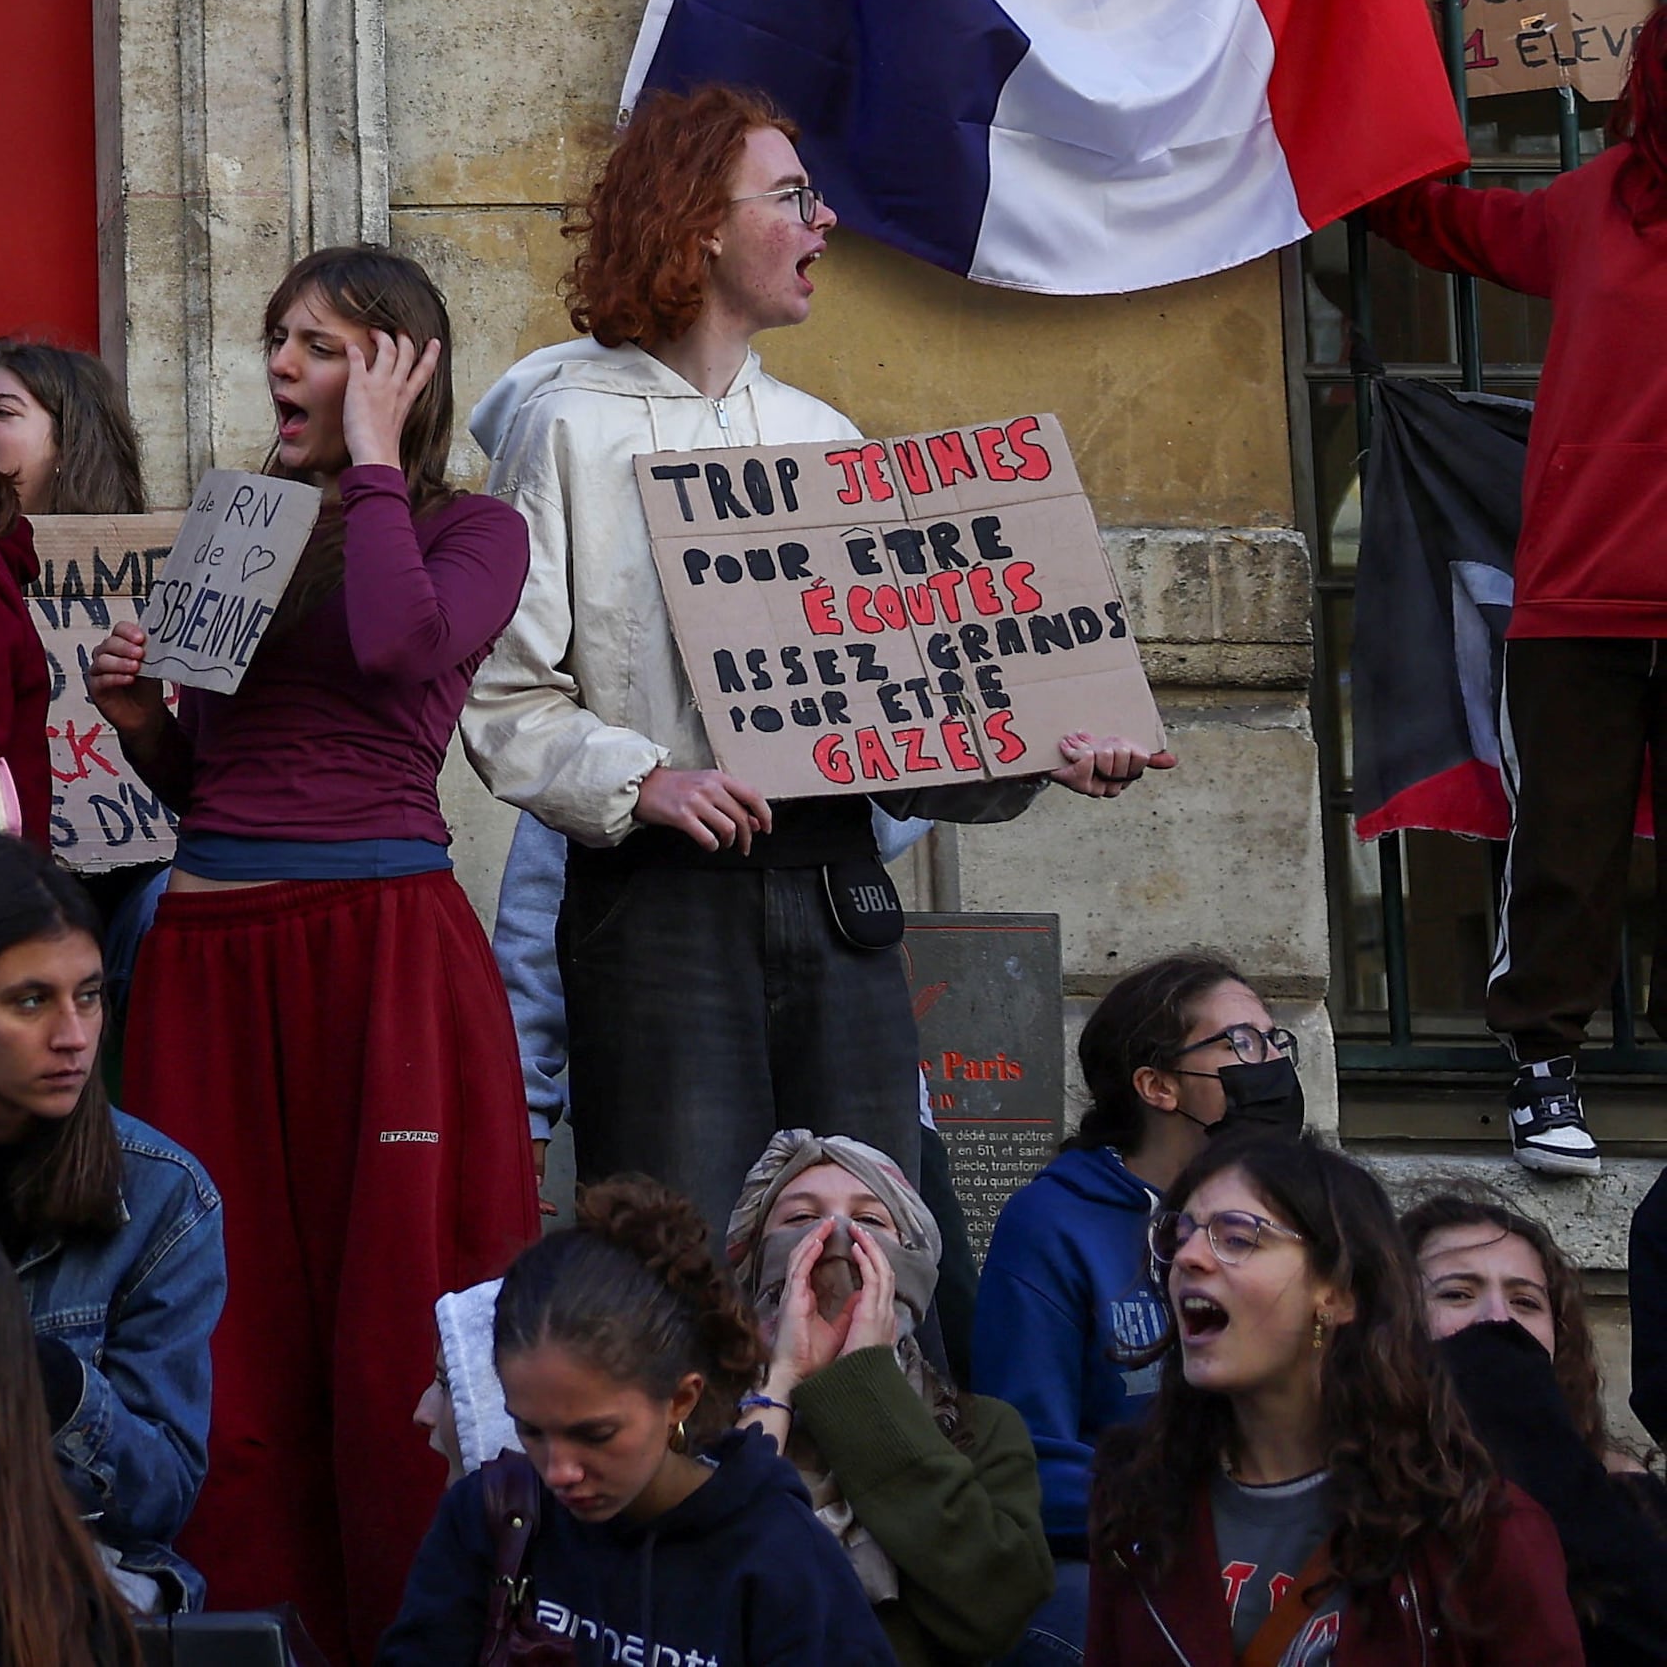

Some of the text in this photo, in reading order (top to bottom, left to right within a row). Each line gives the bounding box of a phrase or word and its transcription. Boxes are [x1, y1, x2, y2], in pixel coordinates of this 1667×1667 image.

[651, 416, 1051, 521] TROP JEUNES
[196, 485, 283, 528] de RN
[194, 534, 225, 566] de
[682, 515, 1013, 586] POUR ÊTRE
[801, 561, 1043, 635] ÉCOUTÉS
[712, 601, 1128, 692] ASSEZ GRANDS
[729, 691, 851, 732] POUR
[812, 710, 1027, 784] GAZÉS
[854, 885, 898, 913] JBL
[942, 1051, 1023, 1081] Paris
[956, 1130, 986, 1141] dédié
[989, 1133, 1008, 1141] aux
[958, 1147, 972, 1155] en
[1002, 1146, 1013, 1156] et
[974, 1175, 987, 1186] du
